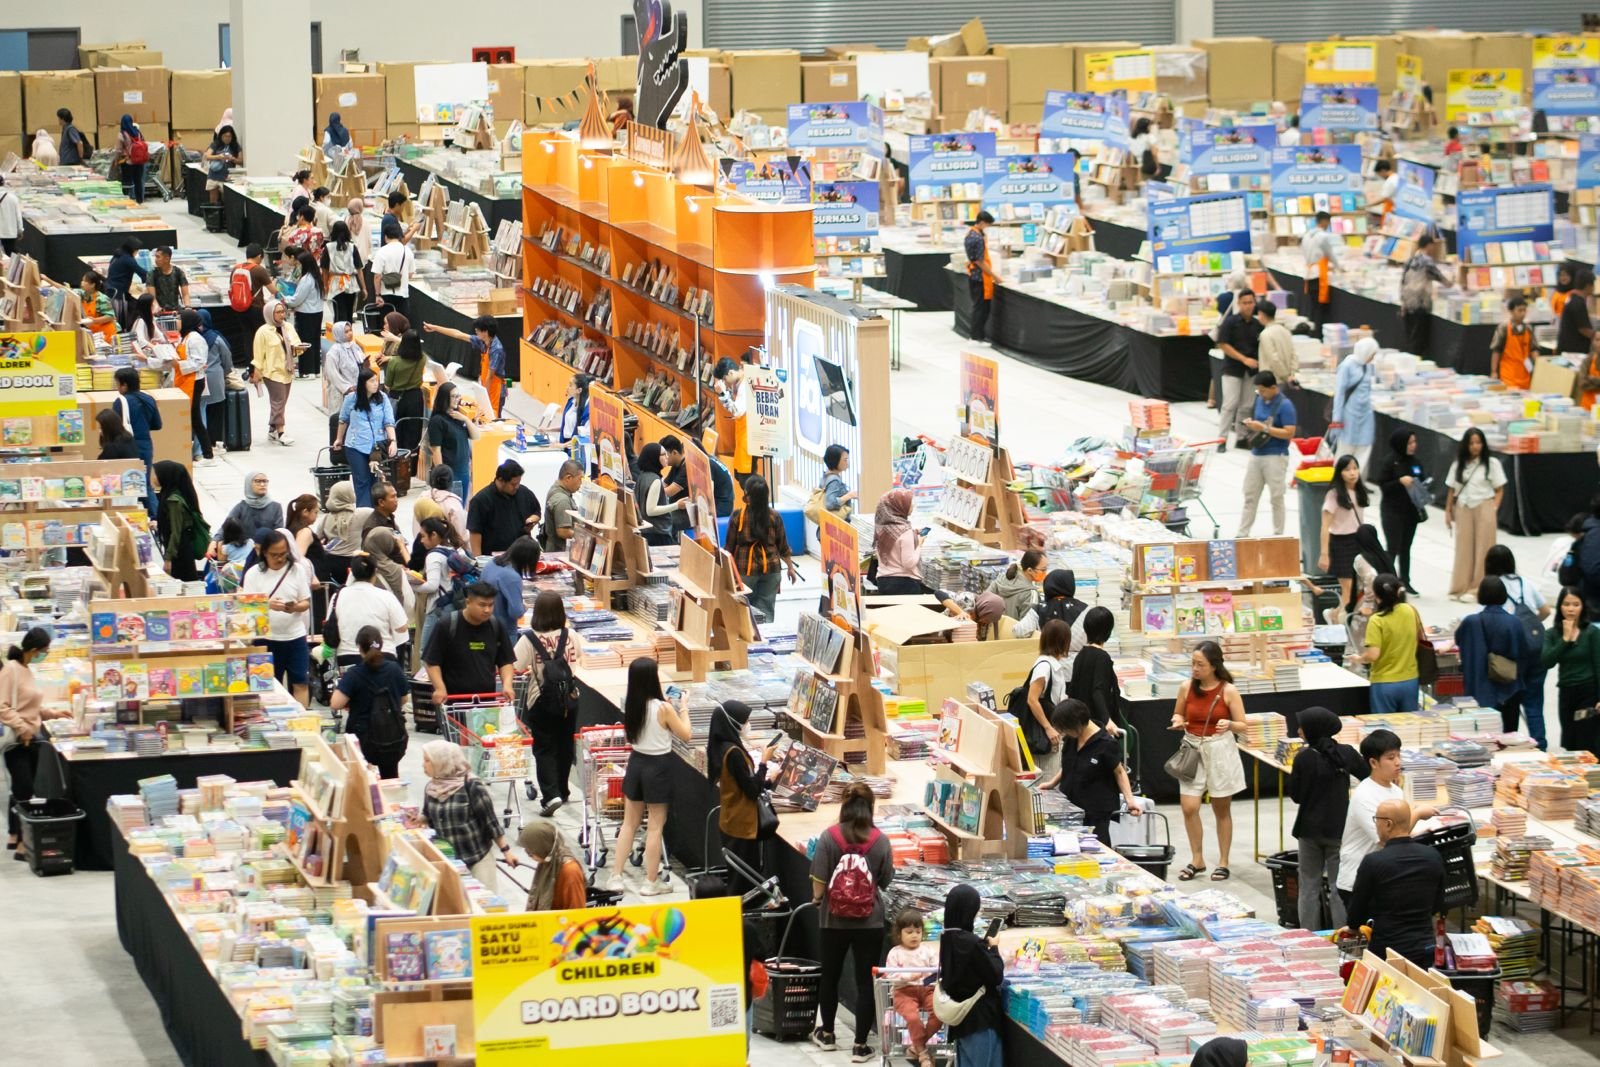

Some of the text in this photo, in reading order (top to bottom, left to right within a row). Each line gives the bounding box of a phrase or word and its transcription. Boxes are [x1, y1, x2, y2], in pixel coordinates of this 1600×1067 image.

[1061, 117, 1105, 131] RELIGION
[808, 127, 852, 138] RELIGION
[1211, 152, 1259, 164] RELIGION
[930, 160, 979, 172] RELIGION
[1289, 173, 1345, 185] SELF HELP
[1001, 182, 1058, 195] SELF HELP
[14, 374, 54, 388] BOOK
[756, 391, 779, 404] BEBAS
[508, 921, 537, 930] DUNIA
[480, 932, 521, 944] SATU
[480, 944, 522, 957] BUKU
[561, 962, 656, 981] CHILDREN
[521, 986, 701, 1024] BOARD BOOK
